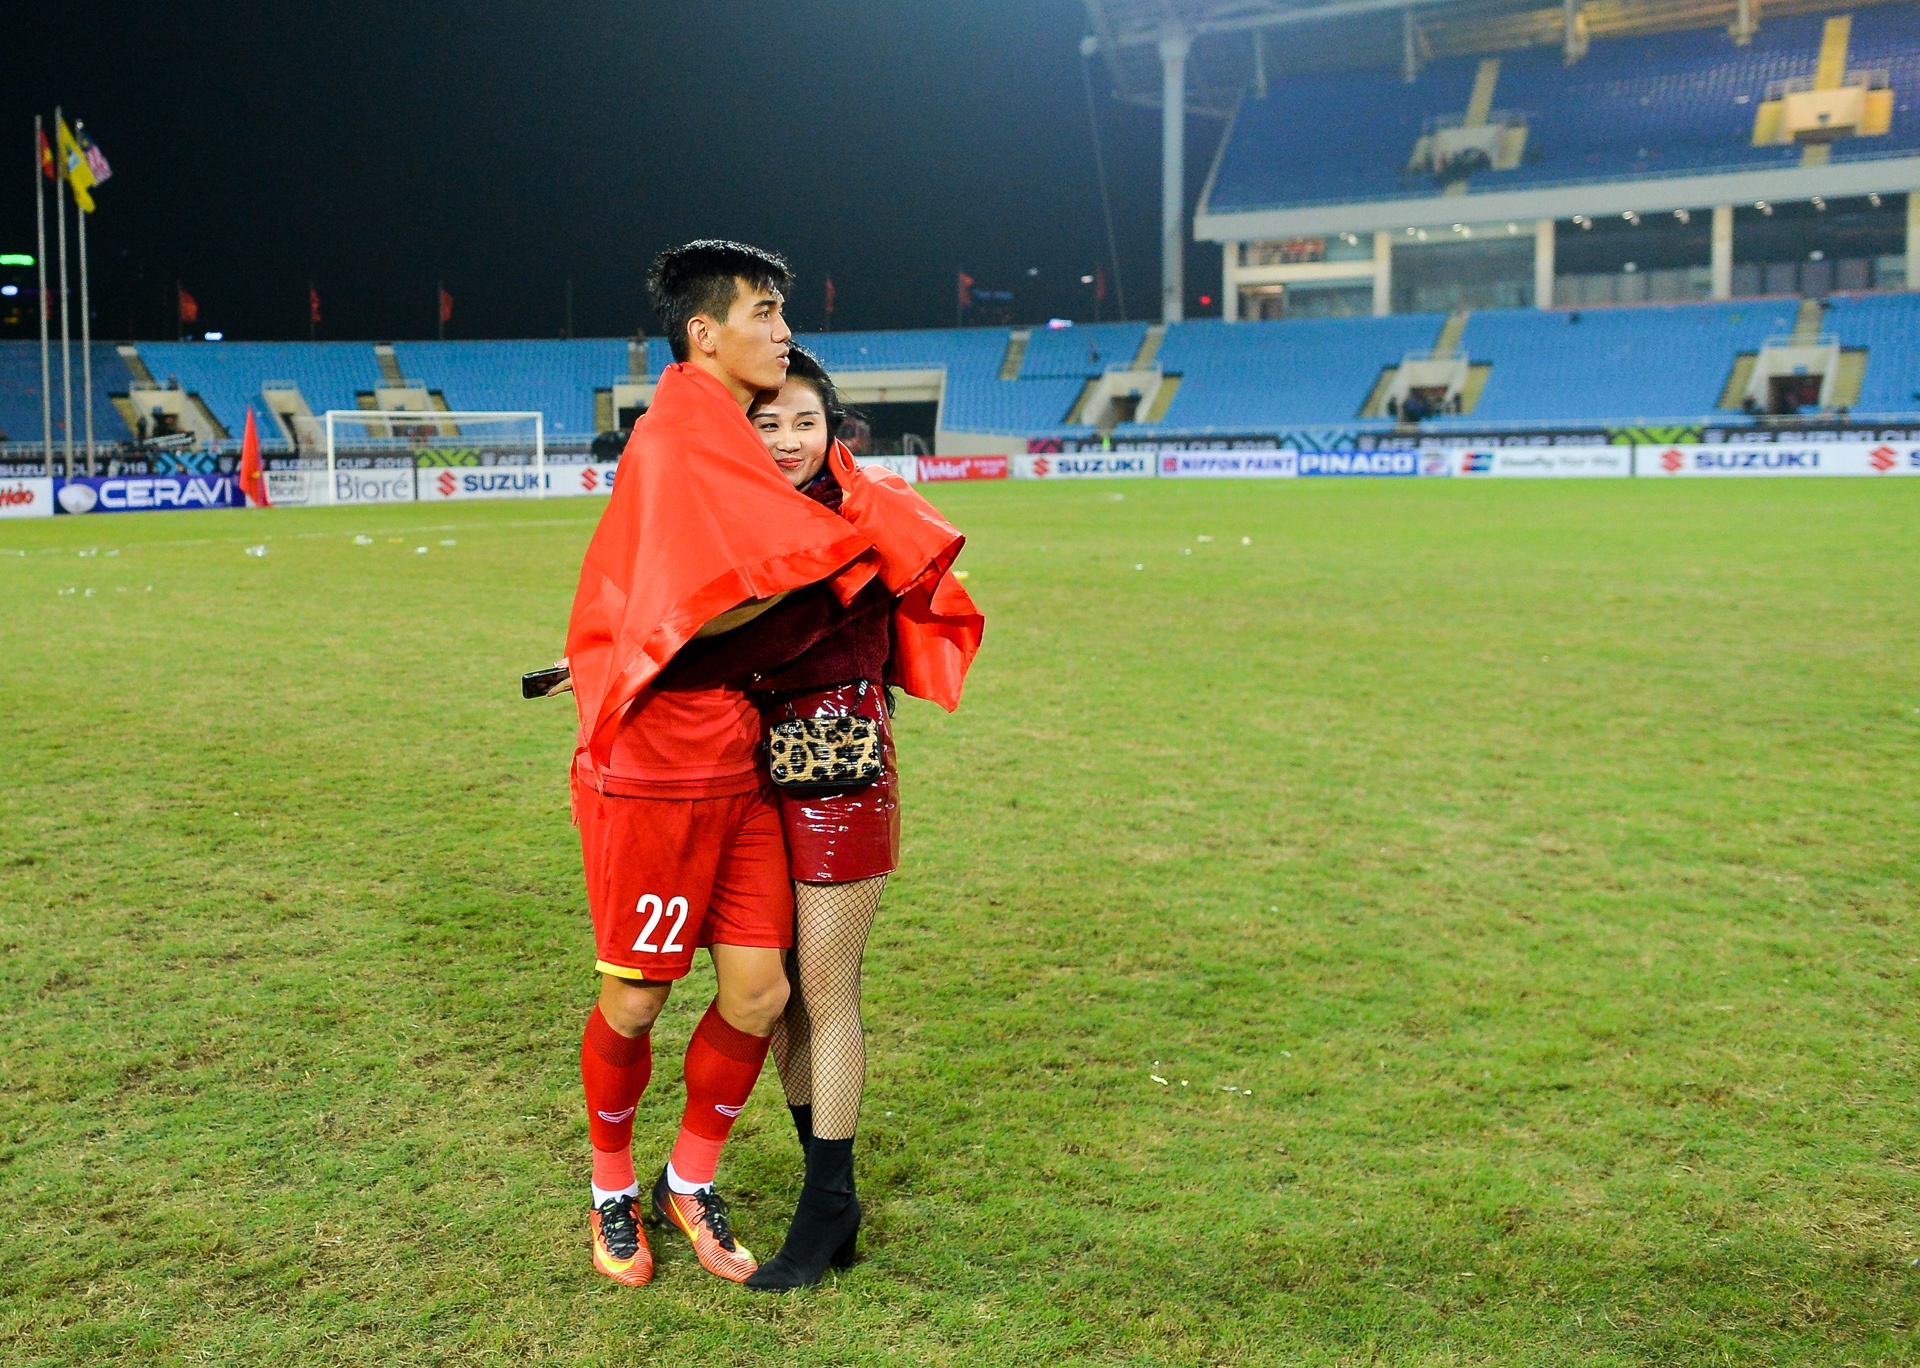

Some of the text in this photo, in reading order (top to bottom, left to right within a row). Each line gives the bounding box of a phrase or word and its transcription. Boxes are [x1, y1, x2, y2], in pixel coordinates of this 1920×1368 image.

[269, 459, 334, 471] SUZUK
[1058, 459, 1144, 473] SUZUKI
[1182, 459, 1293, 470] NIPPON PAINT
[1301, 453, 1414, 474] PINACO
[1696, 453, 1820, 468] SUZUKI
[336, 472, 409, 500] Bioré
[463, 473, 550, 492] SUZUKI
[100, 478, 232, 508] CERAVI
[631, 893, 689, 954] 22
